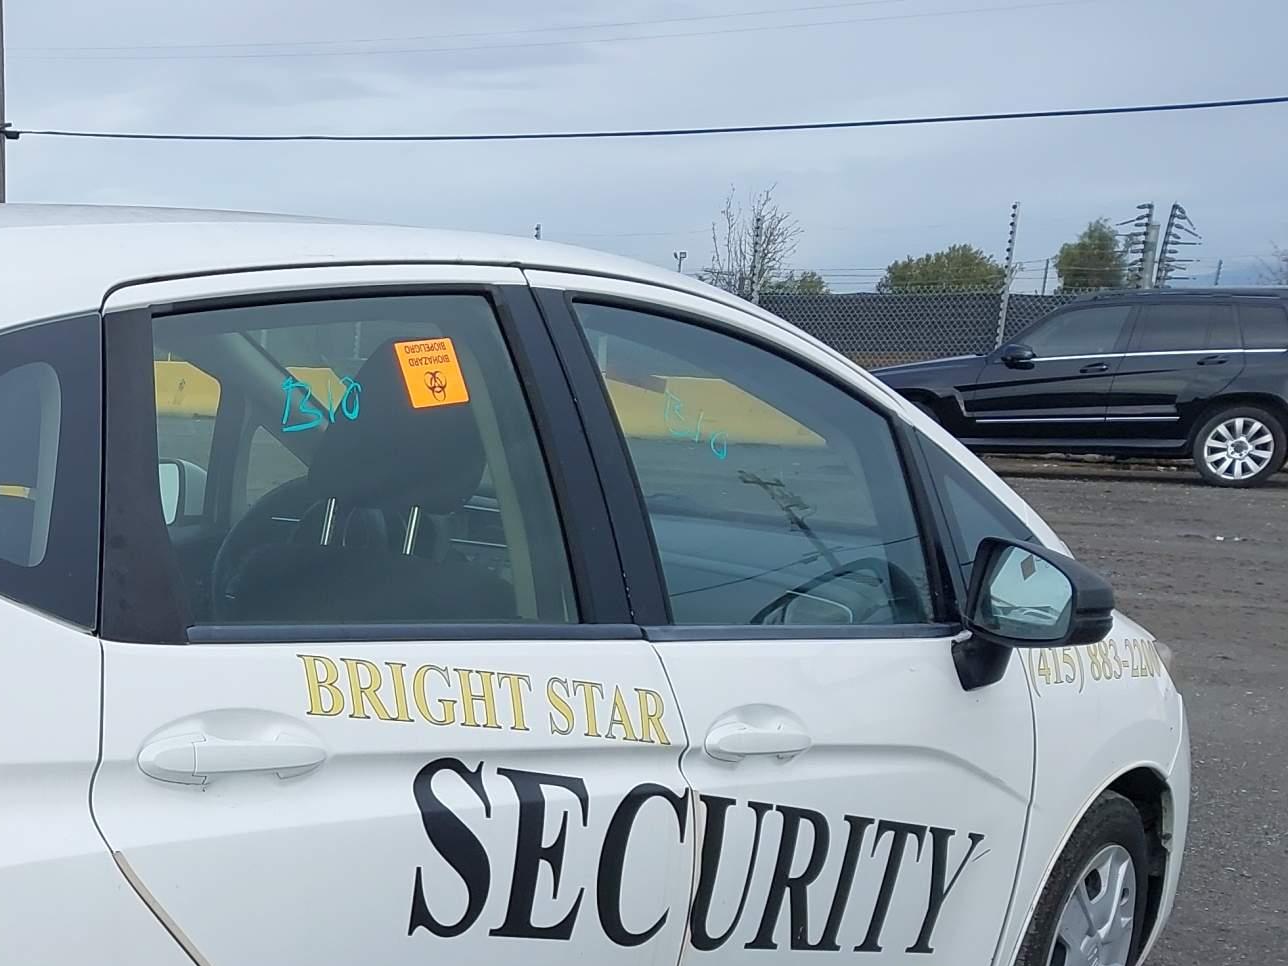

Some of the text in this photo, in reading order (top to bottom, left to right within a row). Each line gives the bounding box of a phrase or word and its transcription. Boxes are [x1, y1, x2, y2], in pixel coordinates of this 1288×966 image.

[404, 341, 447, 355] BIOPELIGRO
[408, 354, 451, 367] BIOHAZARD
[1028, 647, 1086, 697] (415)
[297, 653, 672, 746] BRIGHT STAR
[407, 757, 985, 954] SECURITY
